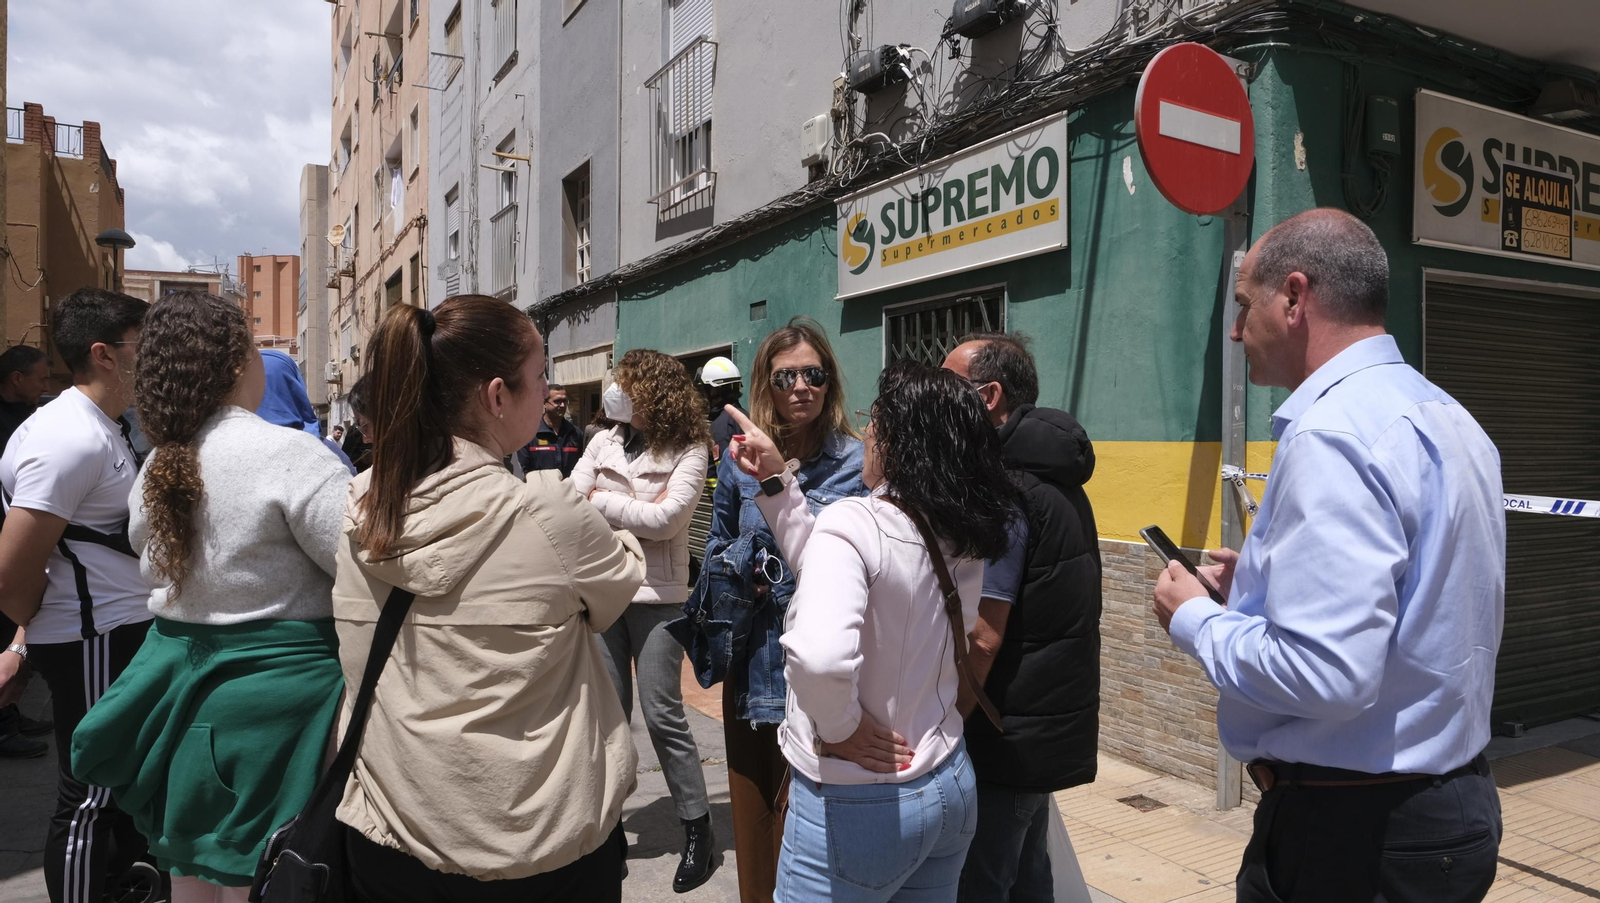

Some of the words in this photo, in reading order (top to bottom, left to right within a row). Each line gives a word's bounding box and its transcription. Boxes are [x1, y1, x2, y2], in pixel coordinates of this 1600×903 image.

[881, 146, 1059, 245] SUPREMO
[1505, 172, 1520, 199] SE
[1524, 176, 1570, 209] ALQUILA
[882, 204, 1056, 262] Supermercados
[1524, 231, 1569, 253] 628101258
